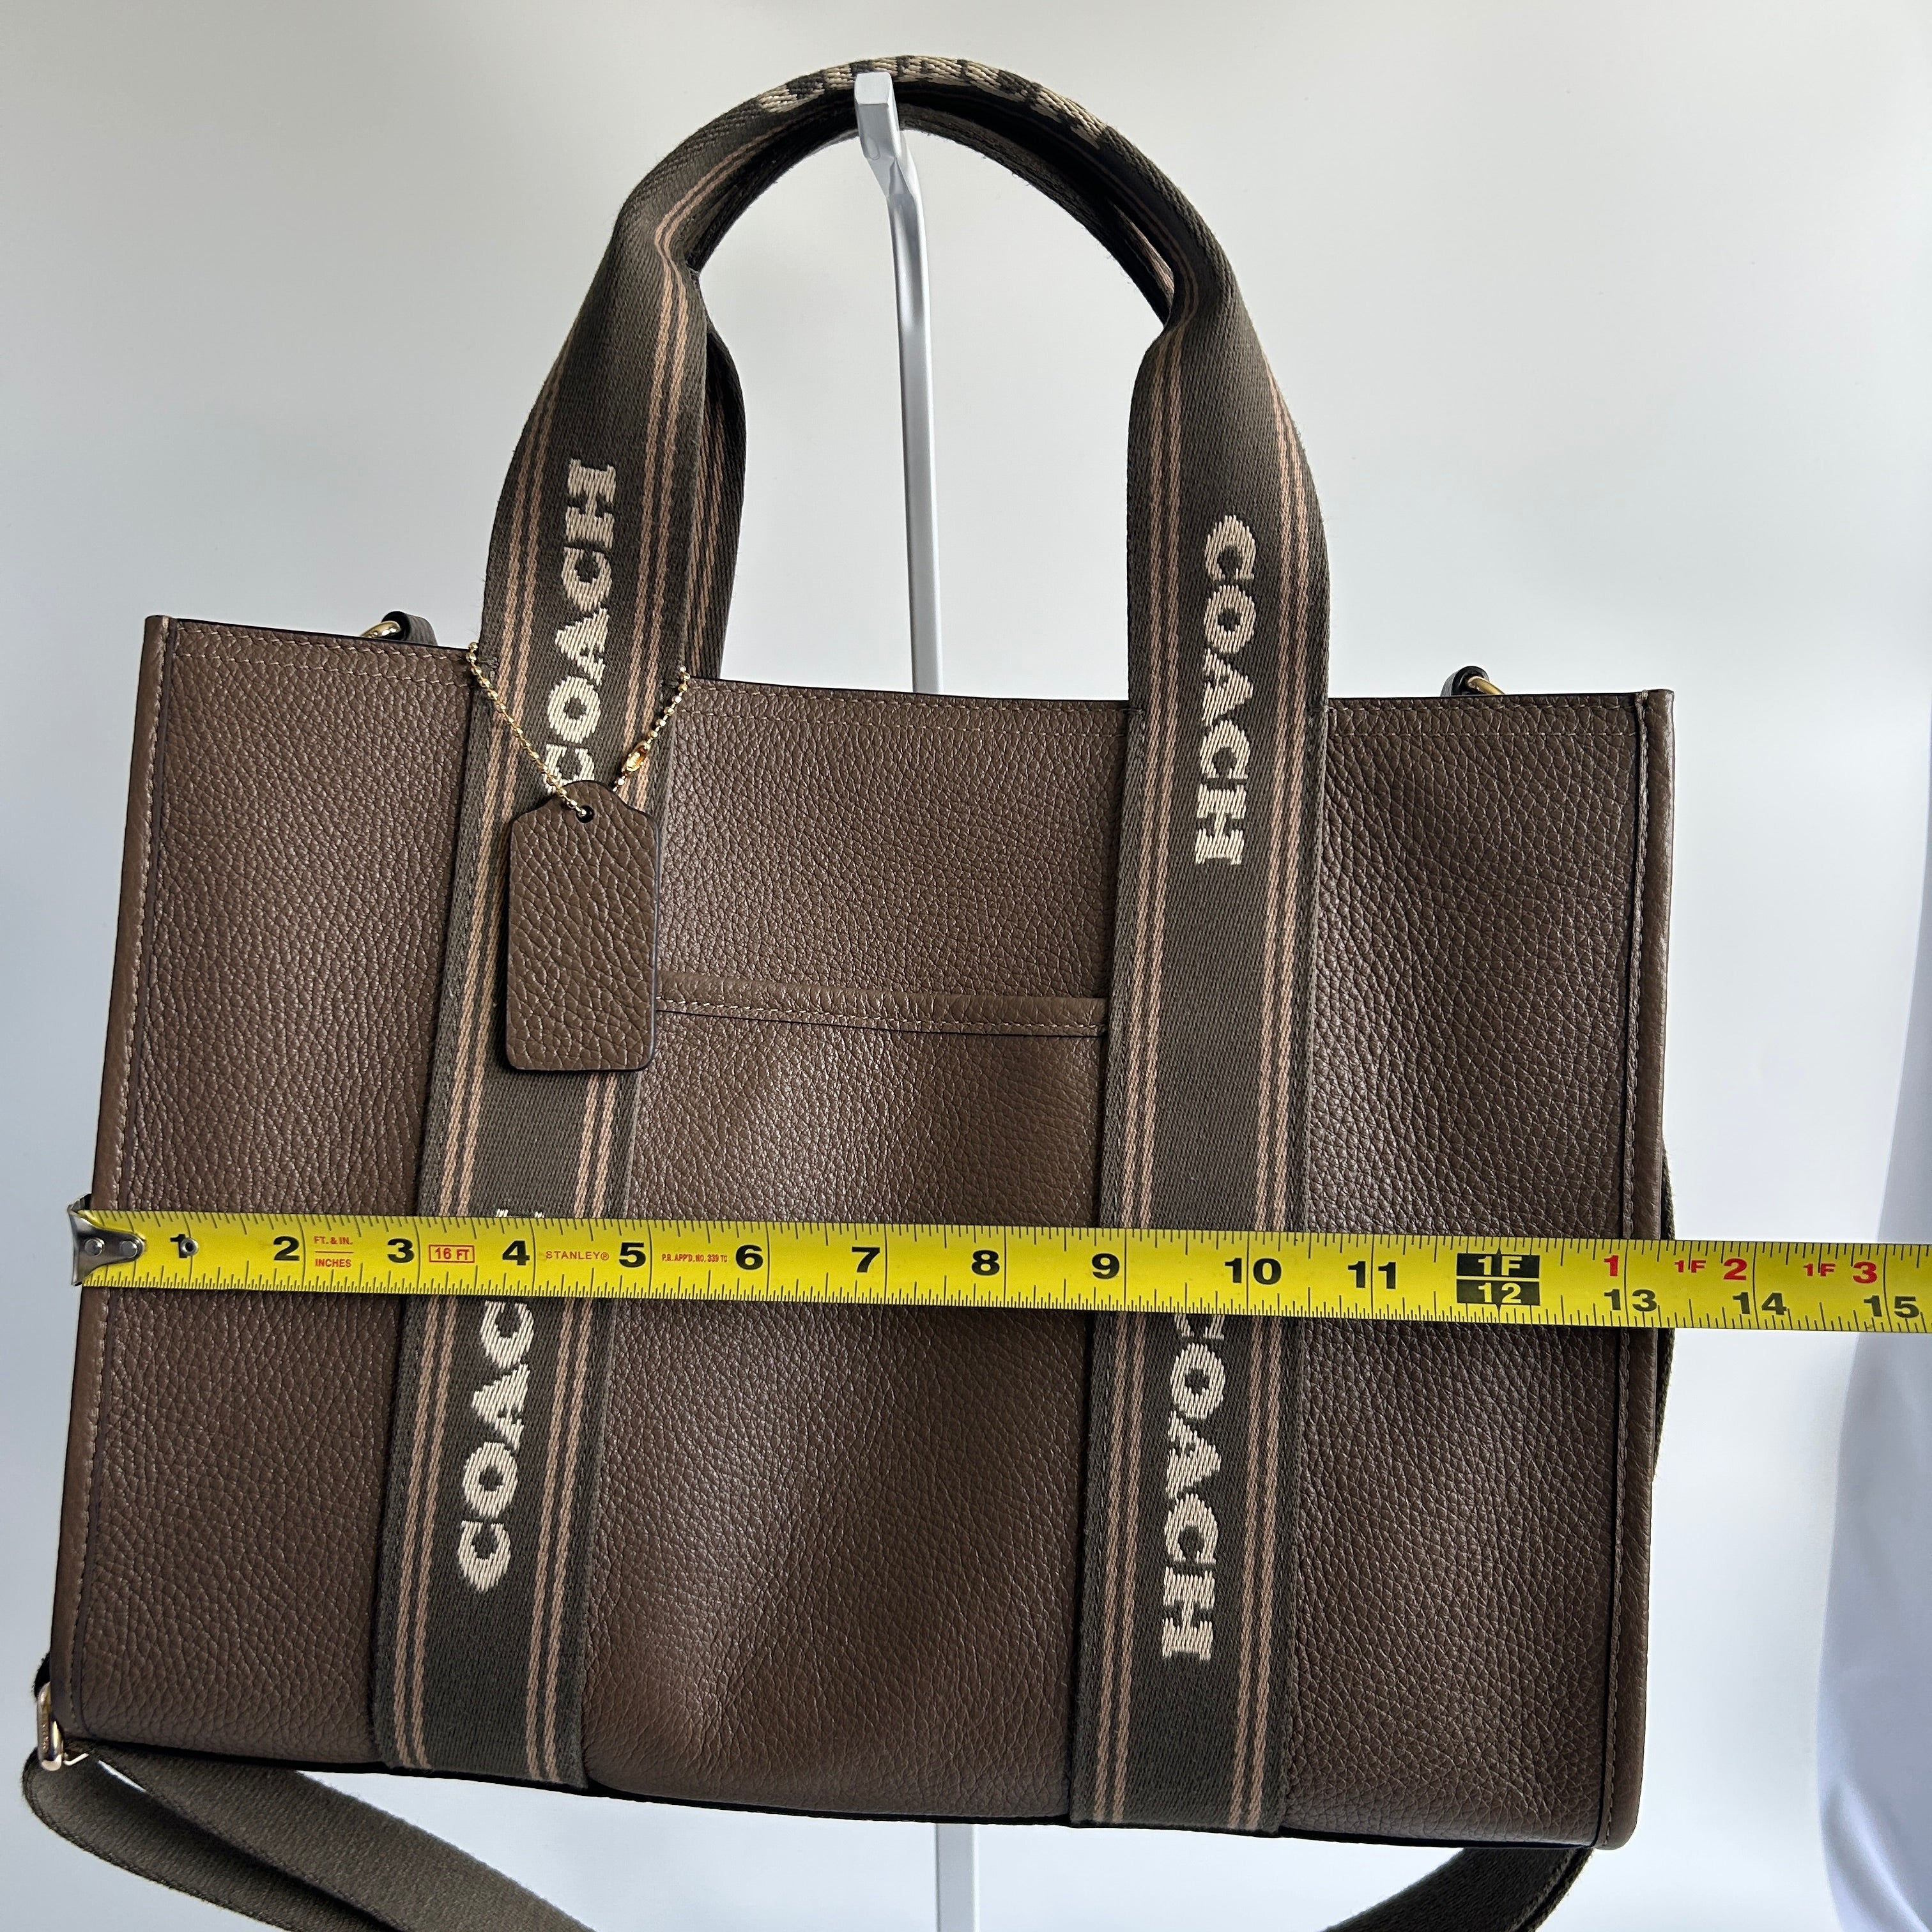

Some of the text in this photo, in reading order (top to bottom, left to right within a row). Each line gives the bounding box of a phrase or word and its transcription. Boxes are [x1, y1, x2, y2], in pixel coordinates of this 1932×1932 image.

[543, 458, 616, 793] COACH
[1195, 514, 1257, 865] COACH
[170, 1234, 188, 1258] 1
[273, 1236, 301, 1262] 2
[313, 1236, 329, 1245] FT.
[339, 1237, 353, 1245] IN.
[387, 1238, 415, 1263] 3
[502, 1240, 530, 1266] 4
[315, 1259, 352, 1268] INCHES
[435, 1247, 470, 1261] 16 FT
[618, 1242, 647, 1268] 5
[735, 1245, 763, 1270] 6
[850, 1246, 880, 1273] 7
[971, 1250, 1000, 1276] 8
[1091, 1253, 1120, 1278] 9
[1478, 1255, 1522, 1276] 1F
[1604, 1255, 1619, 1276] 1
[1224, 1257, 1282, 1285] 10
[1347, 1261, 1397, 1289] 11
[1674, 1257, 1747, 1280] 1F 2
[1803, 1261, 1878, 1284] 1F 3
[1478, 1282, 1522, 1303] 12
[1604, 1288, 1658, 1312] 13
[1732, 1291, 1787, 1315] 14
[1864, 1294, 1920, 1319] 15
[457, 1299, 534, 1593] COAC
